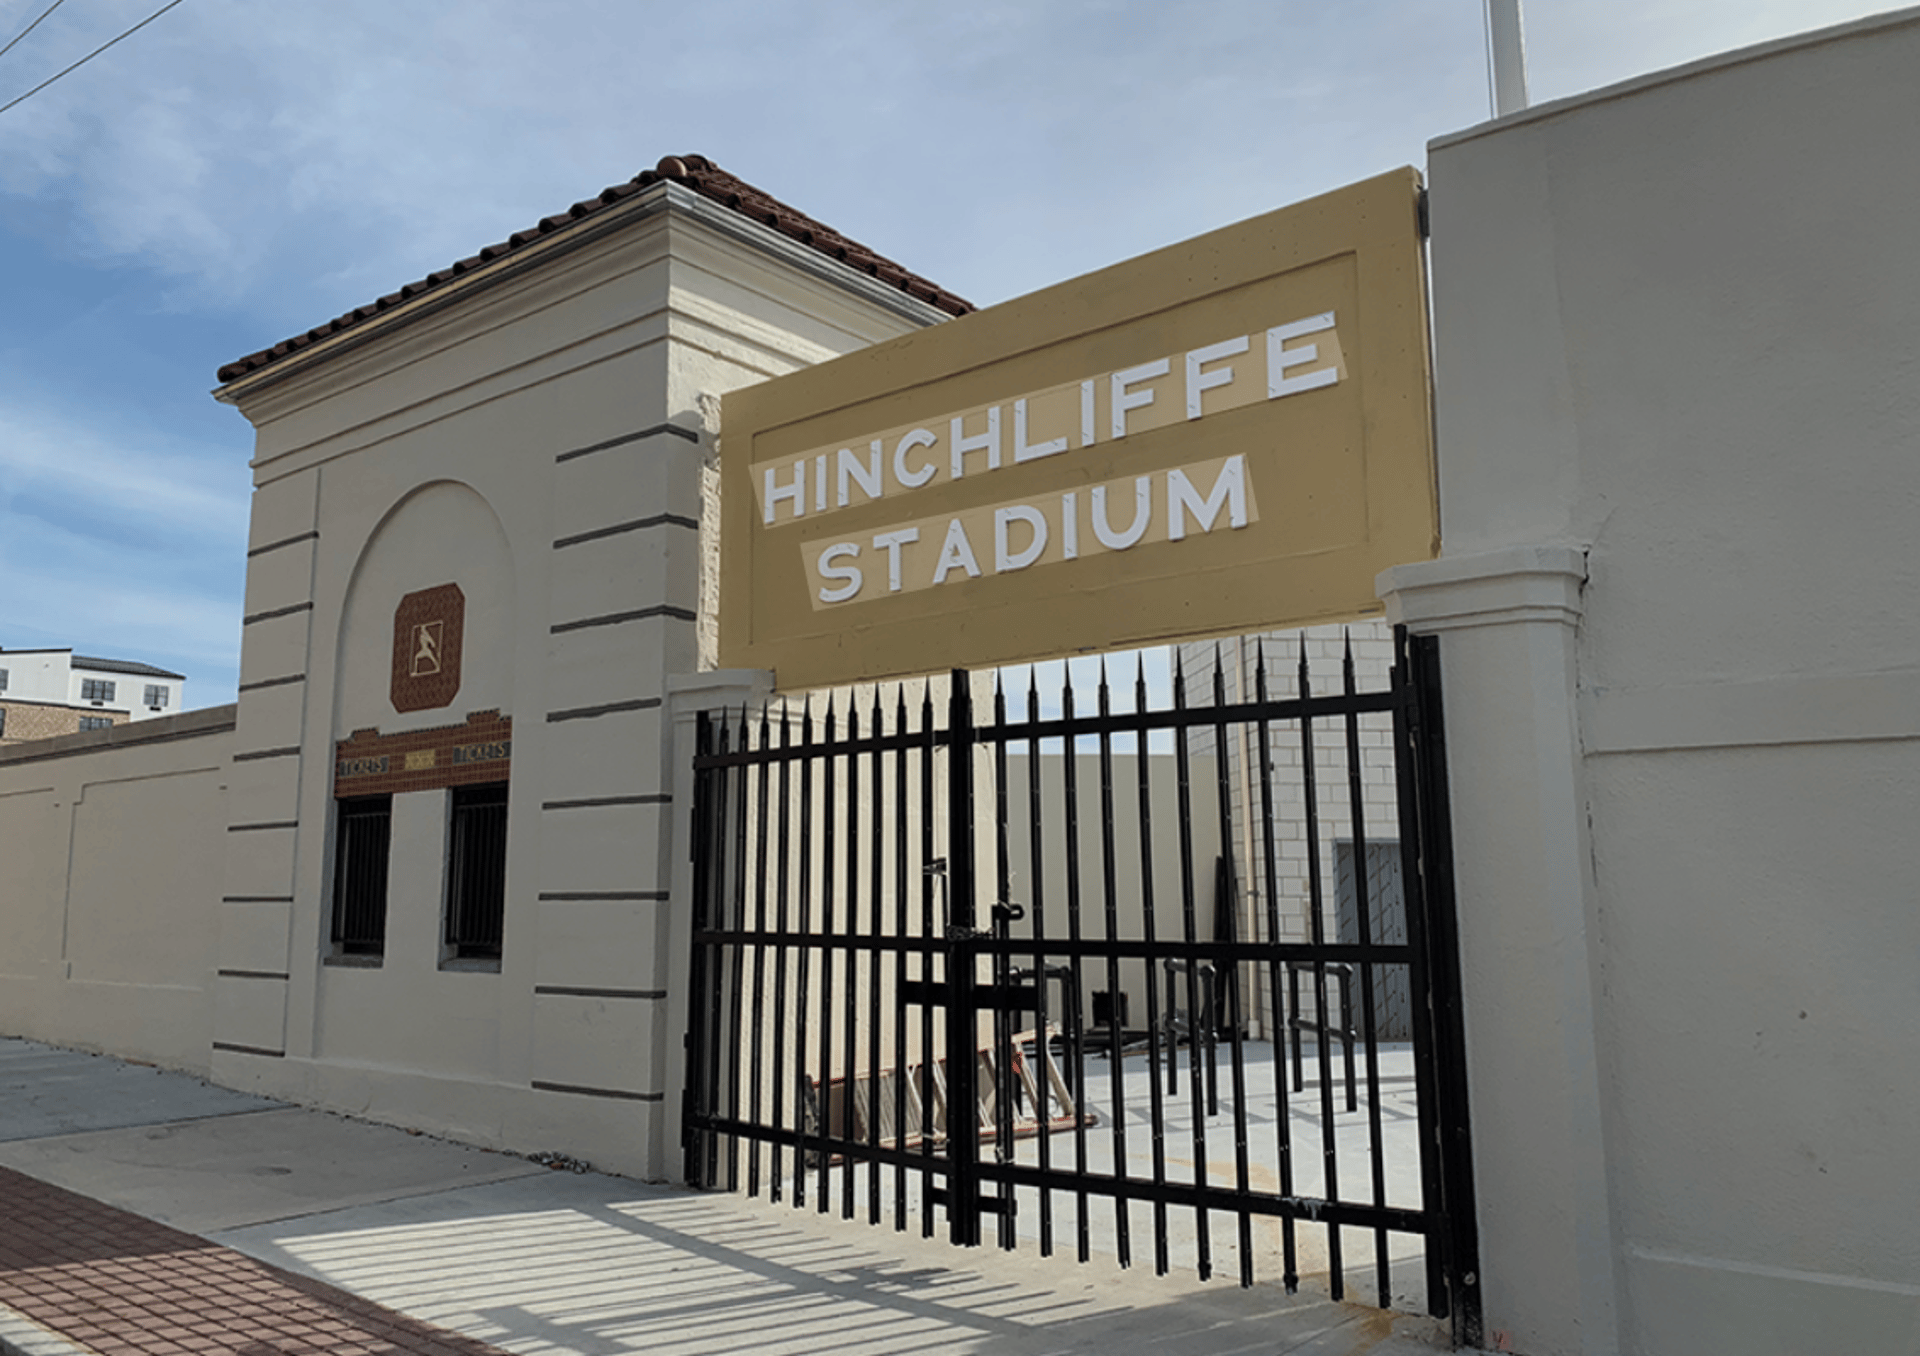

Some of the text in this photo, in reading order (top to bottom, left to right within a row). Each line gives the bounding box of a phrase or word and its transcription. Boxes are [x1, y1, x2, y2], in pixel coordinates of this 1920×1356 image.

[763, 311, 1338, 523] HINCHLIFFE
[817, 455, 1248, 602] STADIUM
[342, 757, 383, 776] TICKETS
[461, 742, 505, 762] TICKETS
